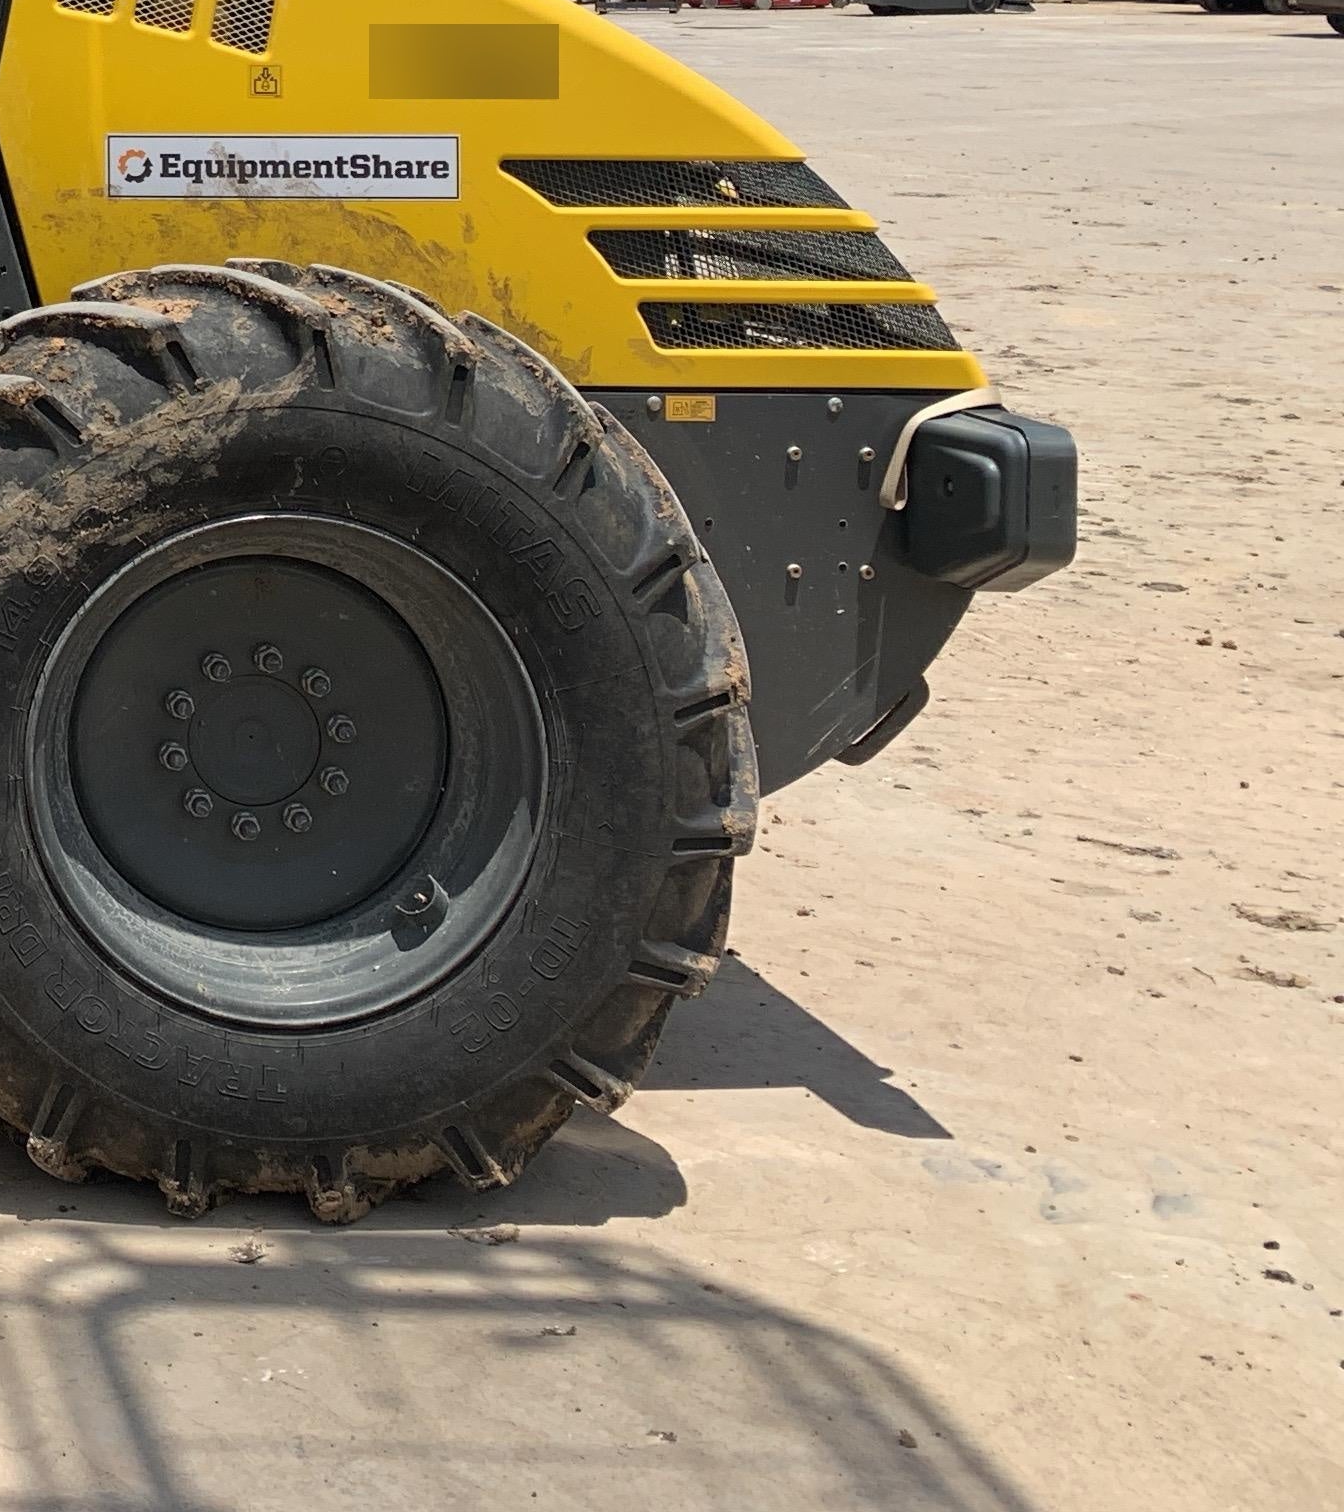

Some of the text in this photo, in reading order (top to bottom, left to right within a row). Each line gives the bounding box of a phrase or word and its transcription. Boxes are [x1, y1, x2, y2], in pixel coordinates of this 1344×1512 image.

[160, 153, 450, 184] EquipmentShare
[406, 450, 602, 630] MITAS
[43, 958, 288, 1103] TRACTOR
[449, 913, 592, 1053] TD-02
